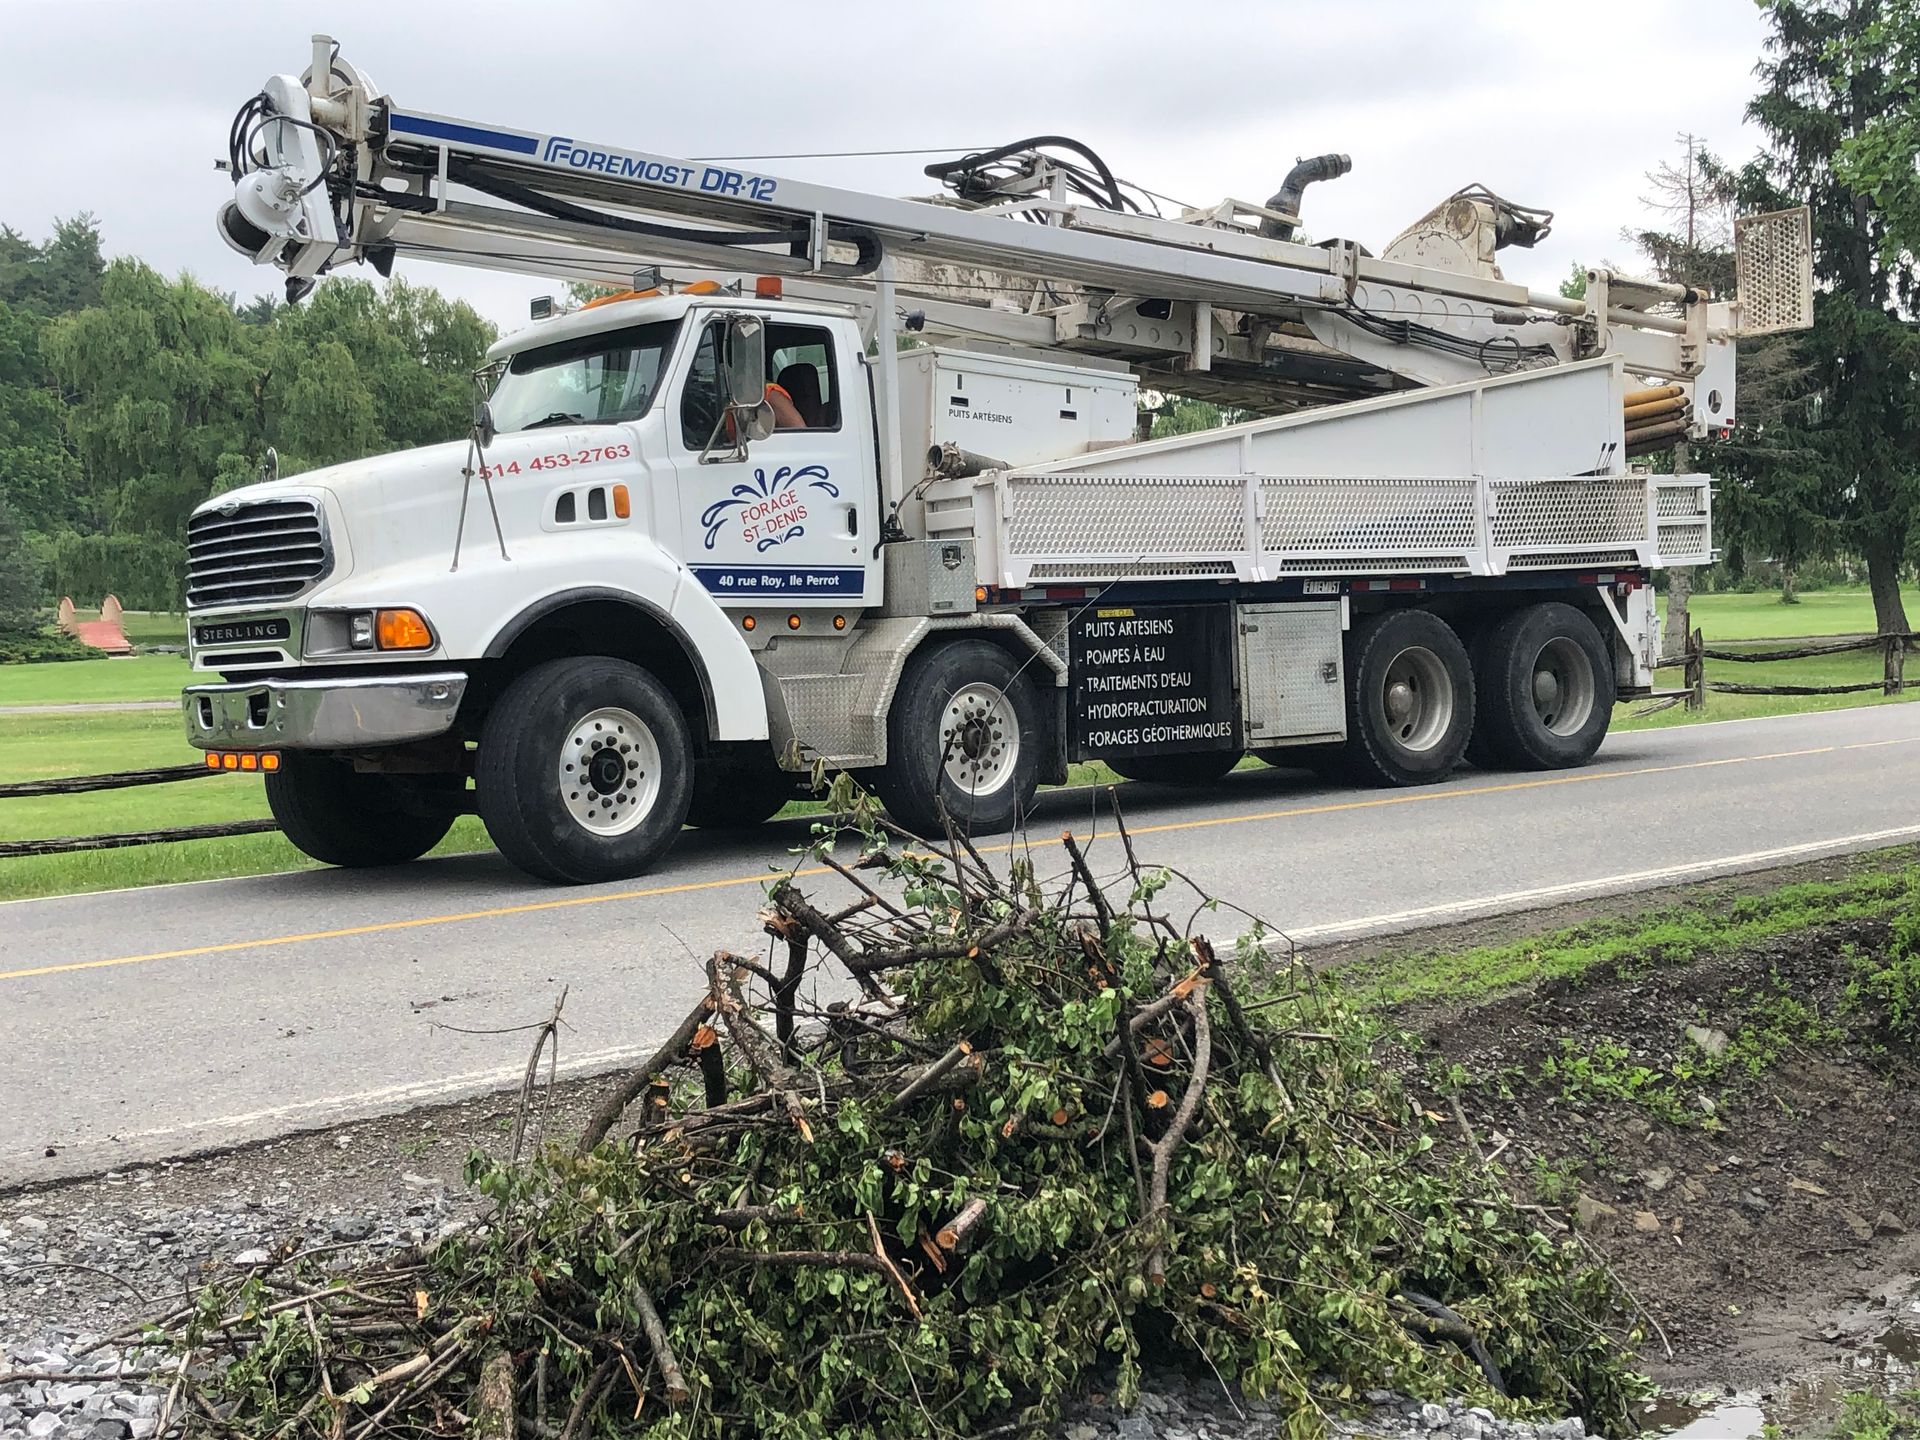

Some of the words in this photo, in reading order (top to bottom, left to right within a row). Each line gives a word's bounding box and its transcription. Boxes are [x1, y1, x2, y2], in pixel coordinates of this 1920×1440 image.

[543, 136, 695, 186] FOREMOST
[948, 409, 970, 419] PUITS
[972, 410, 1013, 424] ARTÉSIENS
[479, 461, 521, 480] 514
[529, 444, 631, 471] 453-2763
[741, 489, 799, 525] FORAGE
[743, 505, 808, 543] ST-DENIS
[719, 575, 734, 586] 40
[738, 577, 757, 586] rue
[761, 575, 785, 589] Roy,
[789, 575, 803, 586] Ile
[806, 575, 840, 586] Perrot
[203, 624, 278, 640] STERLING
[1085, 621, 1116, 638] PUITS
[1118, 617, 1174, 637] ARTÉSIENS
[1086, 648, 1130, 665] POMPES
[1133, 644, 1142, 663] À
[1144, 647, 1165, 662] EAU
[1087, 673, 1158, 693] TRAITEMENTS
[1161, 672, 1191, 688] D'EAU
[1088, 697, 1207, 720] HYDROFRACTURATION
[1088, 729, 1139, 747] FORAGES
[1142, 721, 1232, 744] GÉOTHERMIQUES
